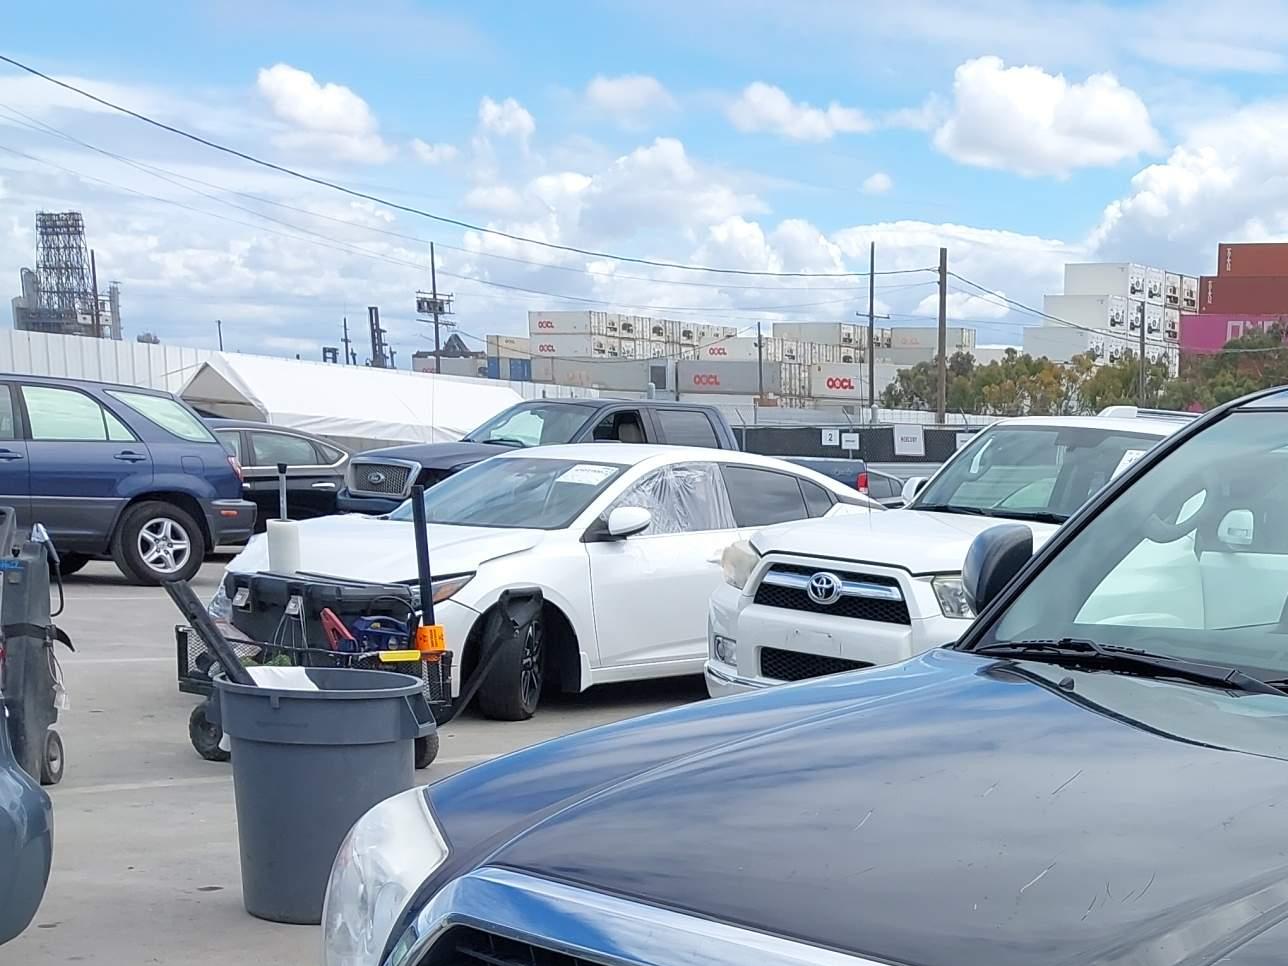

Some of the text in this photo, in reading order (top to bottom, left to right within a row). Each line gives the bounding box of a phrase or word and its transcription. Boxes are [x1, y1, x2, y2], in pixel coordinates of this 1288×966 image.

[693, 374, 720, 385] OOCL
[826, 376, 855, 390] OOCL
[828, 433, 833, 442] 2
